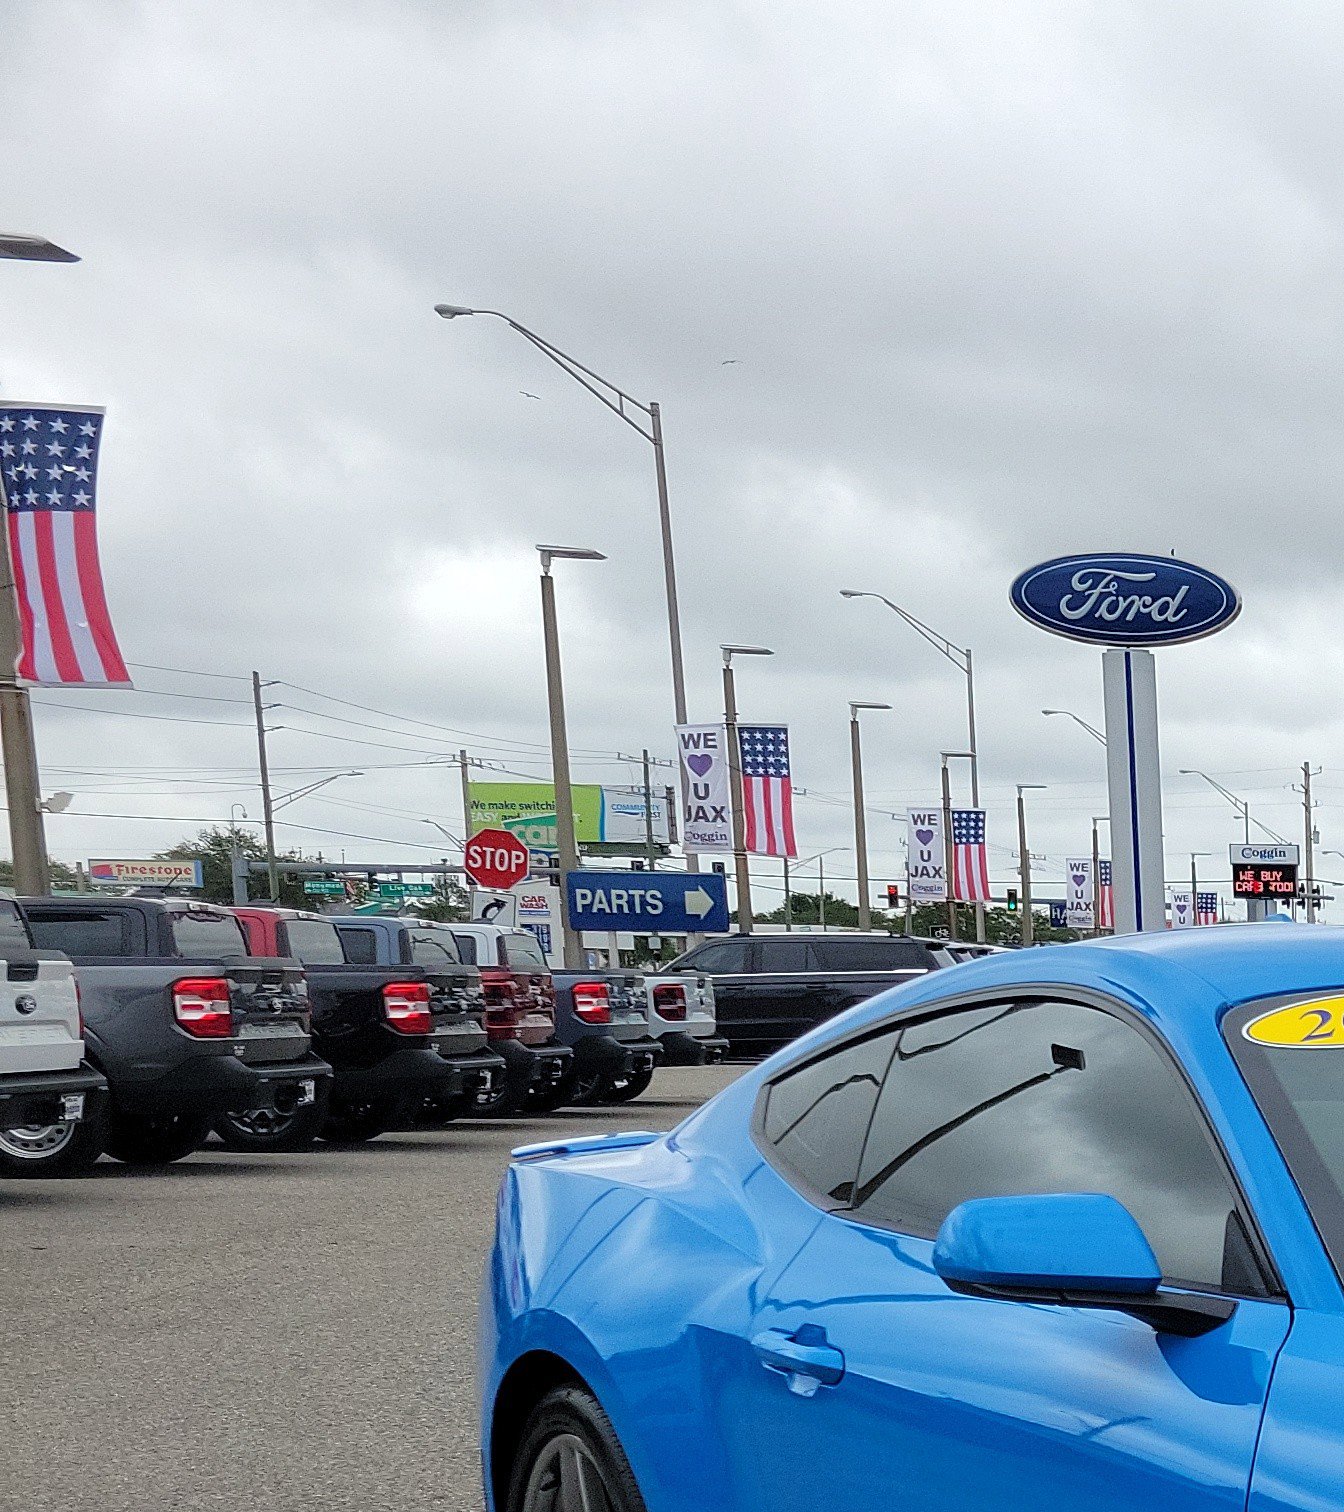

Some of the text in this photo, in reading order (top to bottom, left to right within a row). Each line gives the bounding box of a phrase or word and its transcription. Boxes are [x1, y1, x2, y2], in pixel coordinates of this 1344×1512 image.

[1059, 567, 1189, 622] Ford
[681, 732, 718, 750] WE
[693, 782, 710, 801] U
[488, 800, 517, 810] make
[519, 800, 556, 811] switchi
[611, 803, 661, 811] COMMUNTY
[685, 804, 728, 824] JAX
[911, 813, 938, 826] WE
[684, 830, 728, 842] Coggin
[468, 845, 525, 873] STOP
[919, 849, 932, 862] U
[1241, 847, 1287, 860] Coggin
[116, 864, 192, 875] Firestone
[910, 865, 944, 879] JAX
[1069, 862, 1089, 872] WE
[1239, 871, 1282, 881] WE BUY
[521, 895, 546, 903] CAR
[1074, 889, 1084, 900] U
[1173, 894, 1189, 902] WE
[575, 888, 664, 915] PARTS
[1068, 901, 1092, 911] JAX
[1178, 916, 1186, 925] U
